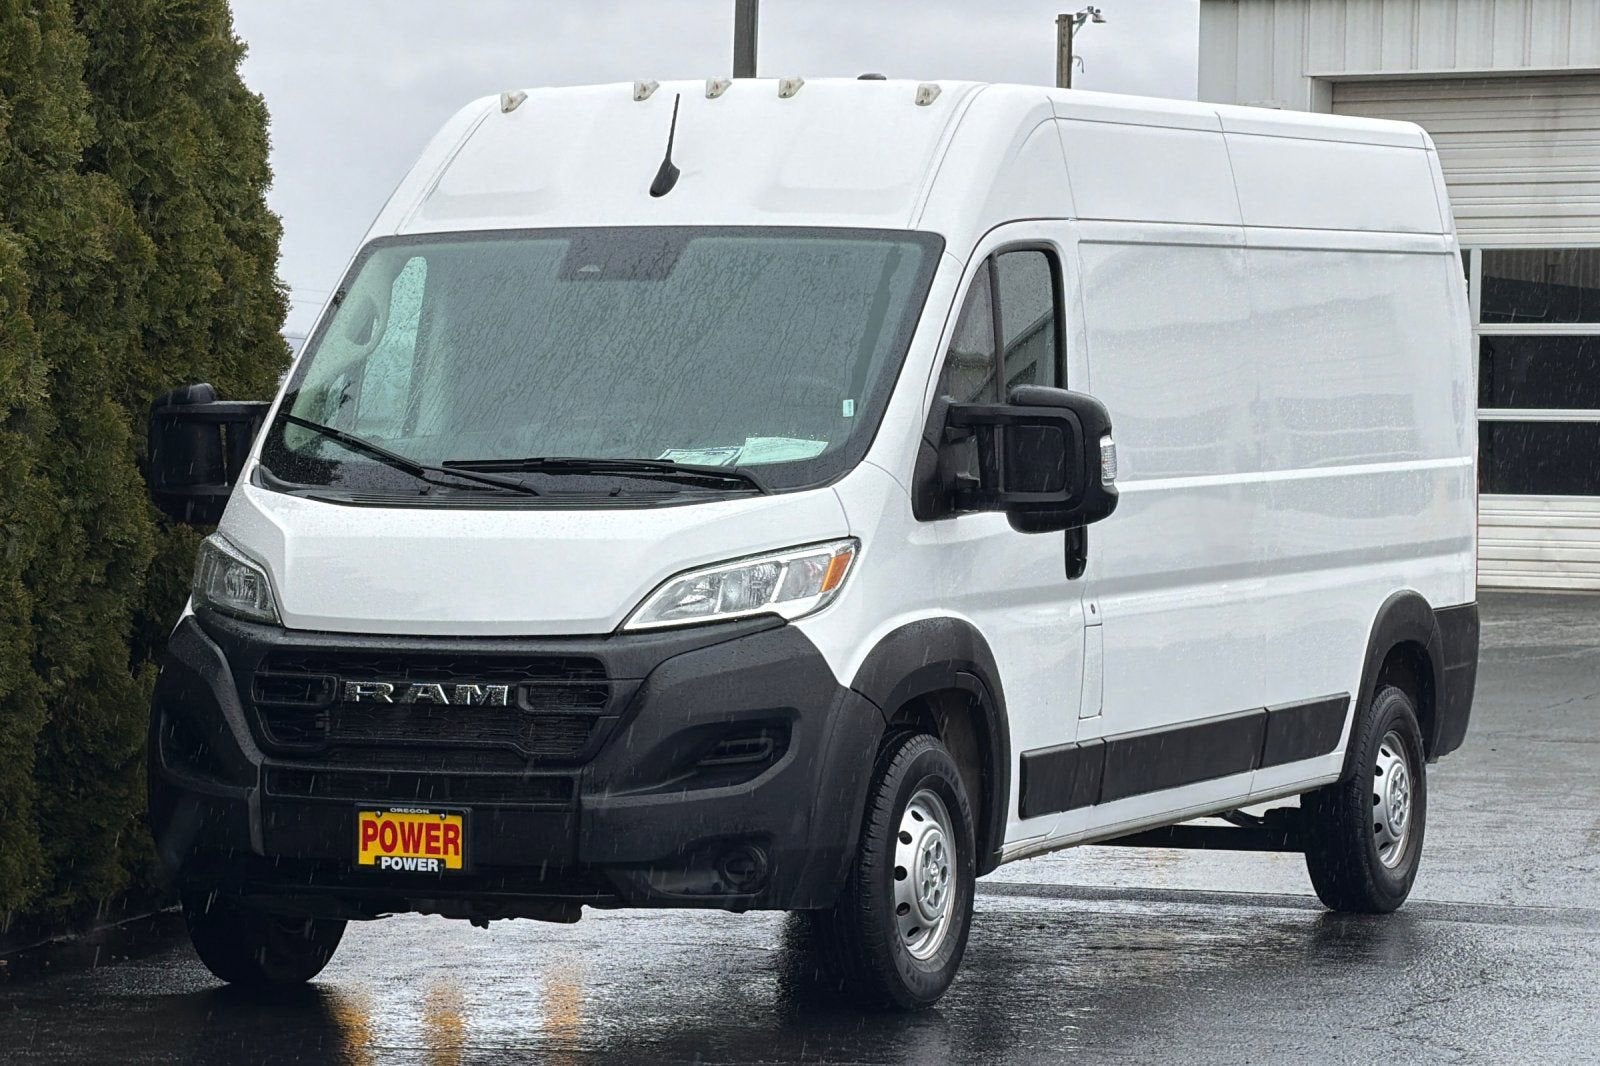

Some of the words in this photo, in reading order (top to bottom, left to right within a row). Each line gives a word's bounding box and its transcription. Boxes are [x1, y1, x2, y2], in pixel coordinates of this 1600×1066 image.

[344, 681, 508, 706] RAM
[361, 819, 460, 856] POWER
[381, 857, 438, 872] POWER
